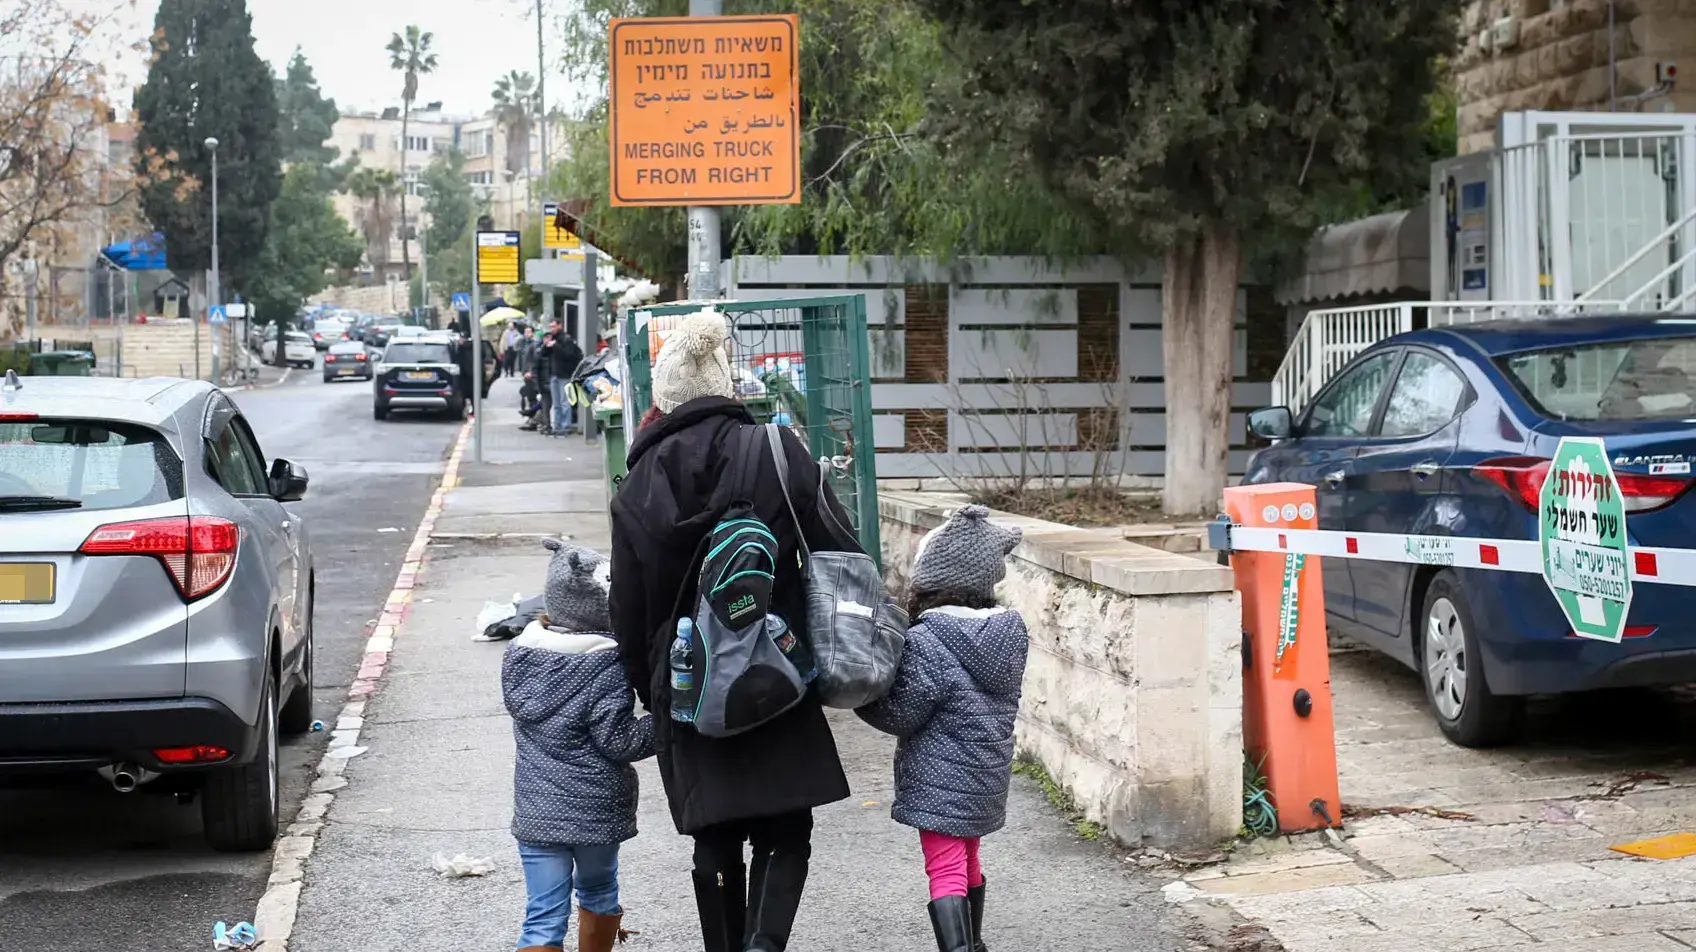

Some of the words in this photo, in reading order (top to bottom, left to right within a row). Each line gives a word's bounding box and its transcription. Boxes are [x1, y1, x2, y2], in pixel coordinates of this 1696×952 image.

[624, 37, 705, 55] משתלבות
[715, 36, 782, 54] משאיות
[636, 64, 688, 84] מימין
[701, 62, 771, 80] בתנועה
[703, 86, 774, 101] شاحنات
[684, 119, 708, 134] من
[625, 142, 705, 159] MERGING
[713, 141, 773, 157] TRUCK
[636, 168, 696, 184] FROM
[708, 166, 773, 183] RIGHT
[1614, 454, 1684, 466] ELANTRA
[1552, 468, 1612, 503] זהירות!
[1546, 500, 1588, 533] חשמלי
[1592, 511, 1618, 539] שער
[1575, 549, 1605, 574] שערים
[728, 594, 755, 613] issta
